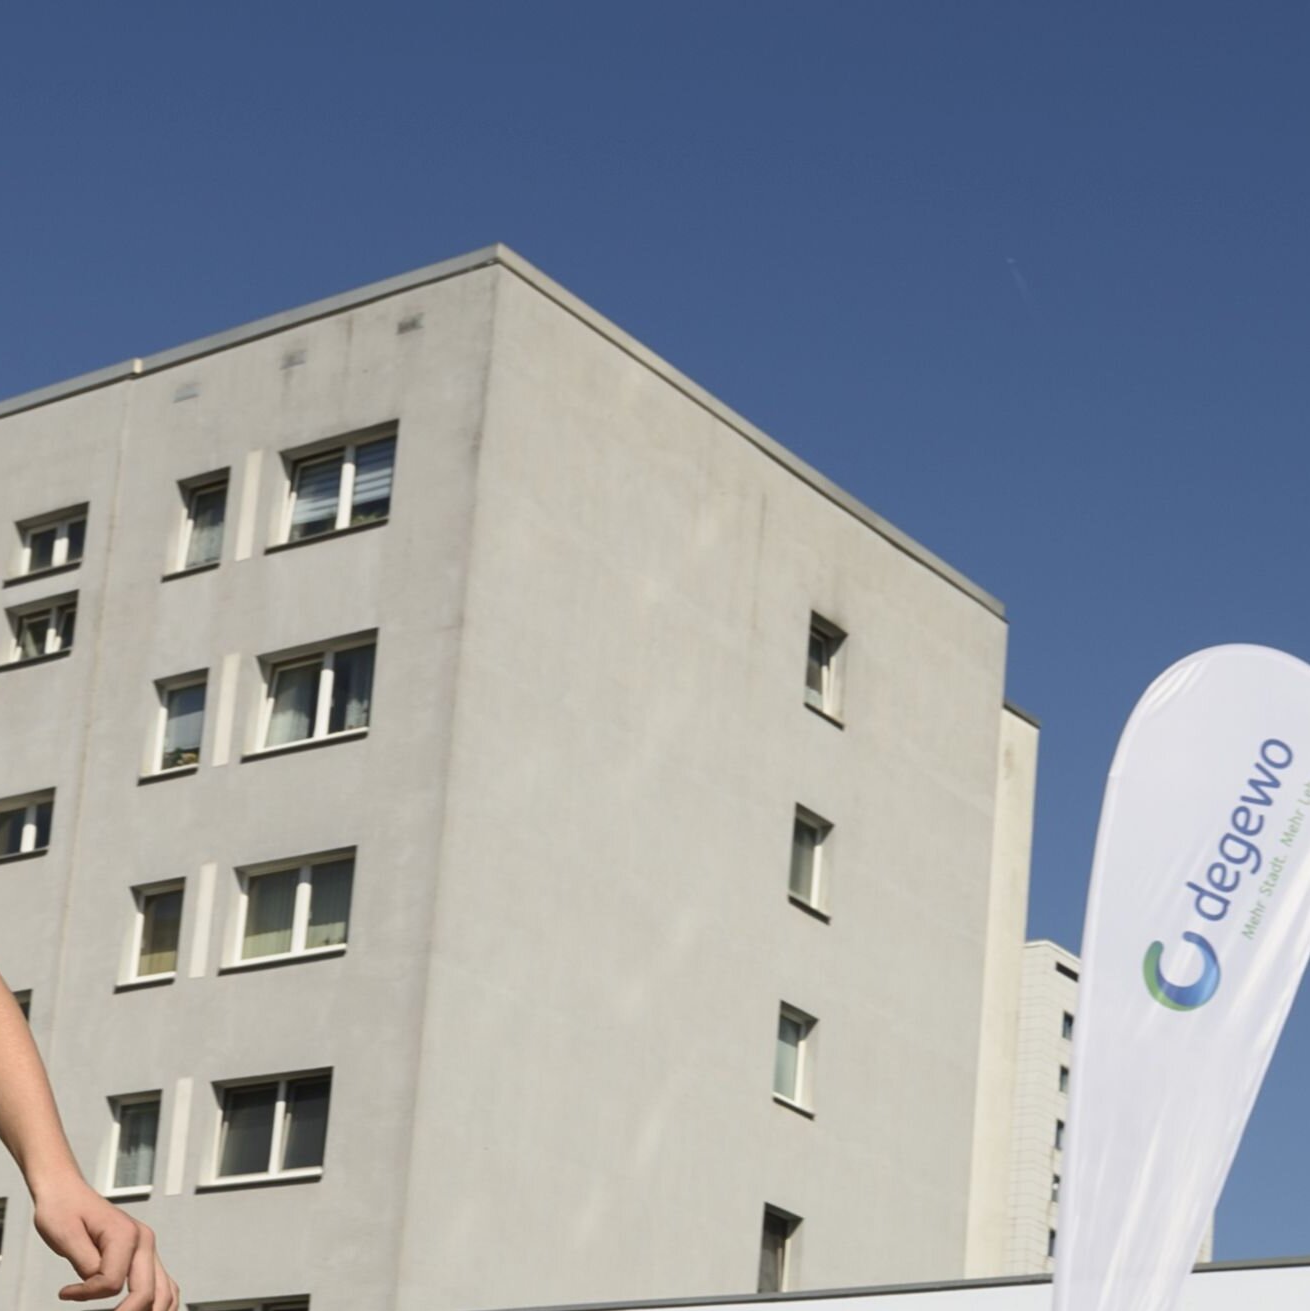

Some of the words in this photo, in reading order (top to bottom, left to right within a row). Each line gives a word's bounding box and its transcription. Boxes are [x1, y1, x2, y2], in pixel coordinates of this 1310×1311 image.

[1186, 738, 1294, 922] degewo
[1241, 900, 1267, 941] Mehr
[1279, 808, 1307, 848] Mehr
